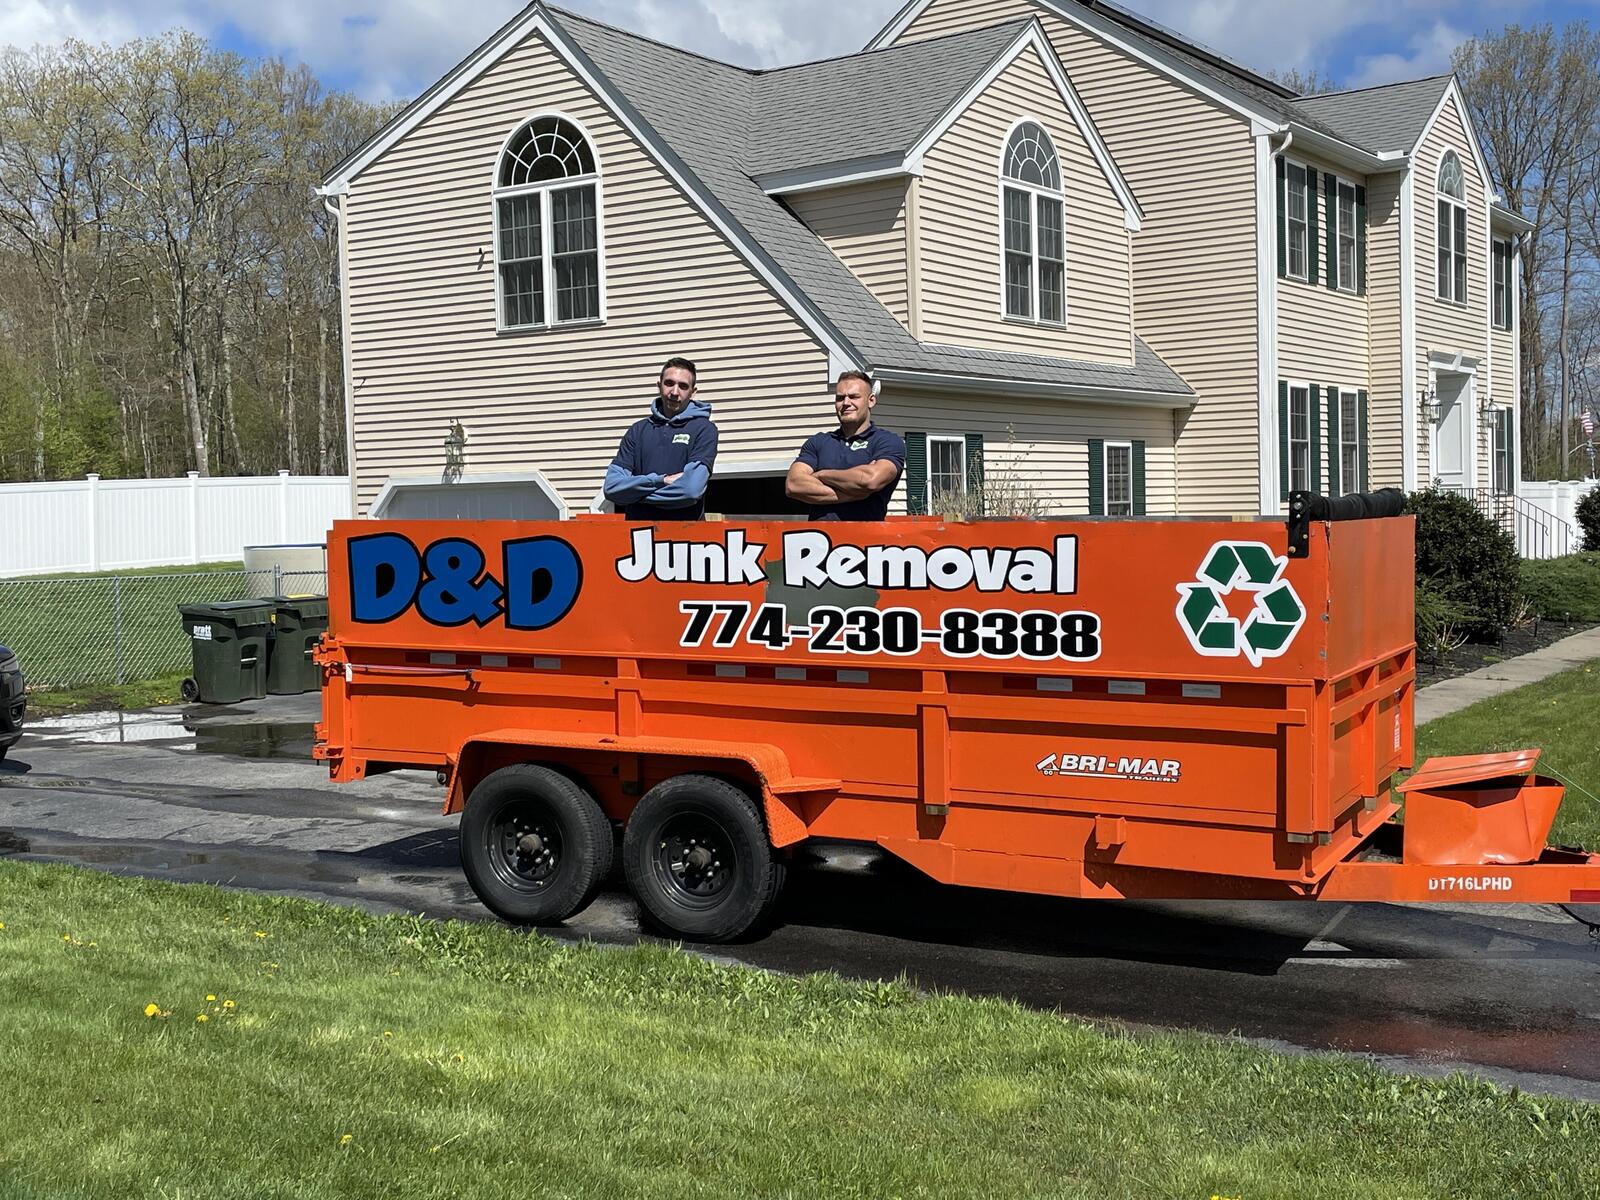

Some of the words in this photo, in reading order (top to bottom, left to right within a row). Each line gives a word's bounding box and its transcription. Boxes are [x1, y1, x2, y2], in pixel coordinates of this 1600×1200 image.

[348, 532, 582, 630] D&D
[615, 527, 766, 585] Junk
[782, 530, 1078, 595] Removal
[679, 599, 1102, 662] 774-230-8388
[1060, 754, 1181, 776] BRI-MAR
[1428, 877, 1512, 890] DT716LPHD
